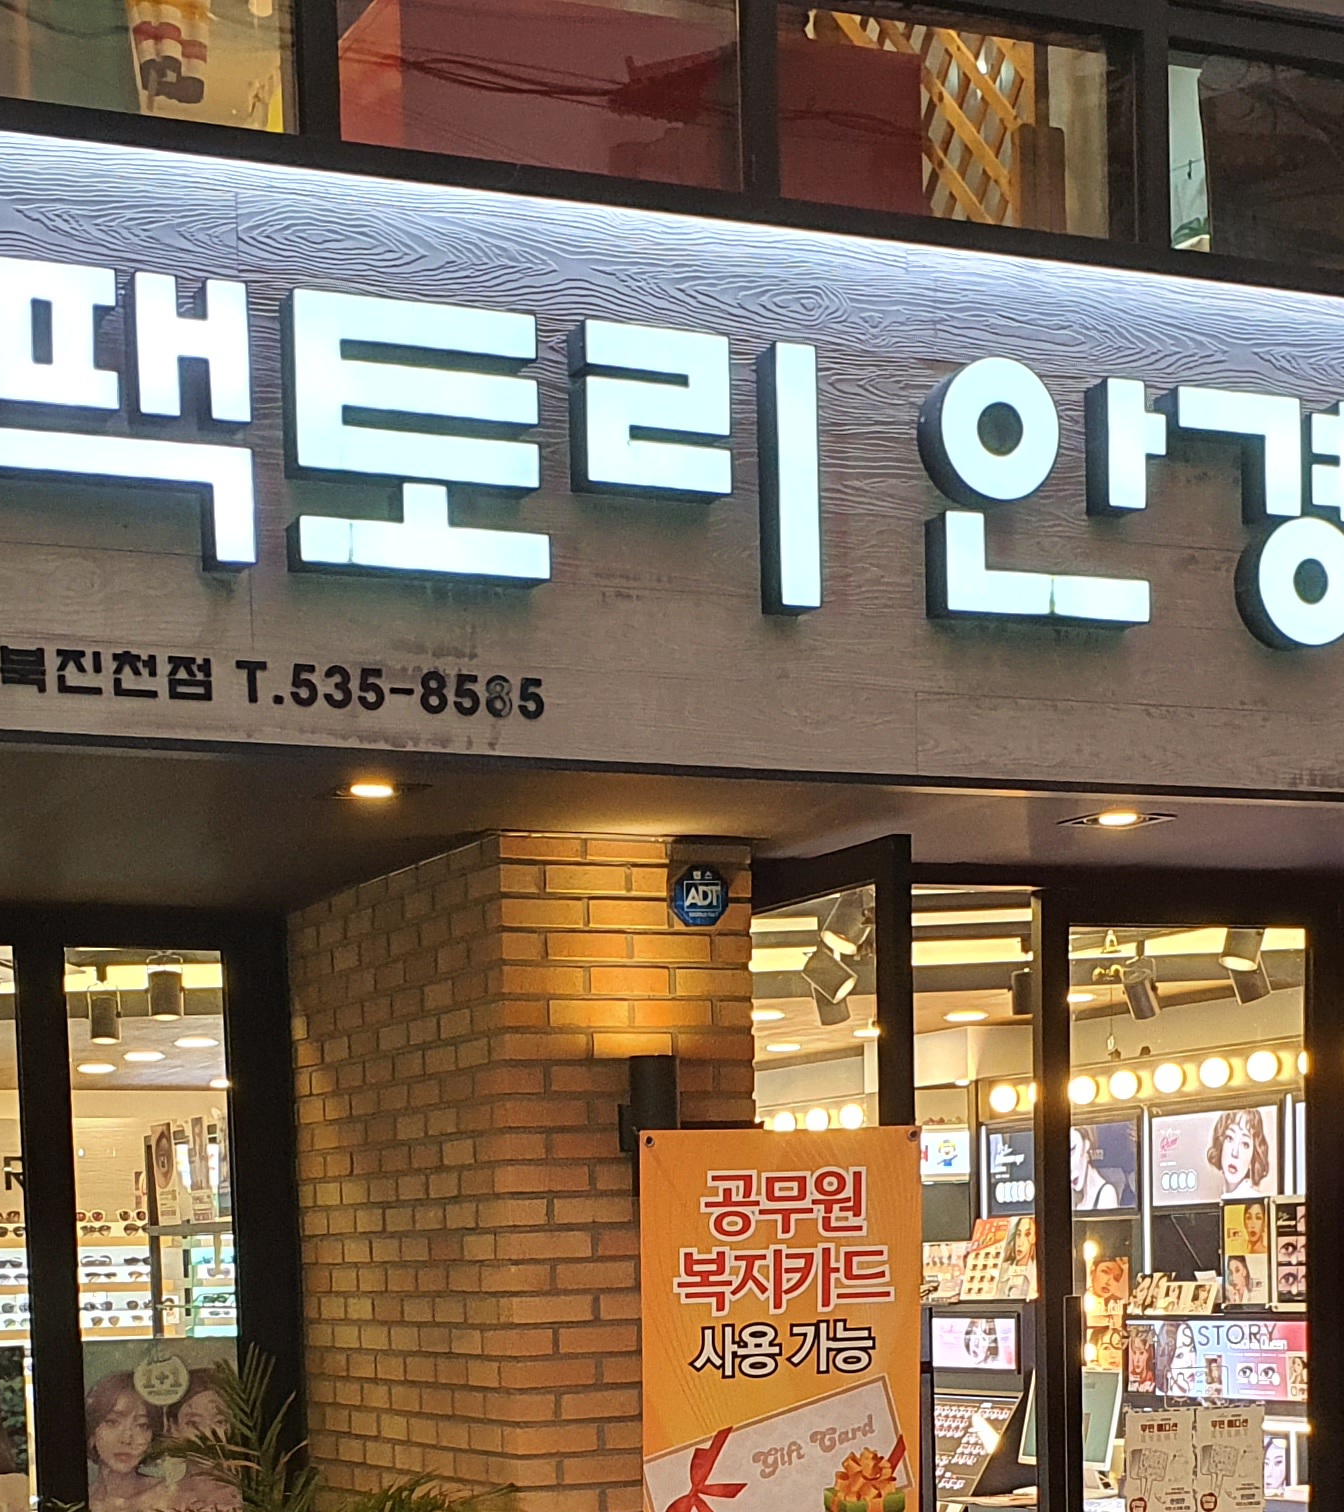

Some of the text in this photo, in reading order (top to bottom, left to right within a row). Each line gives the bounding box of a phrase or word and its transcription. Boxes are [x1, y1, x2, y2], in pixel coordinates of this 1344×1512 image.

[685, 884, 721, 907] ADT
[700, 1165, 868, 1242] 공무원
[672, 1244, 896, 1318] 복지카드
[690, 1318, 877, 1380] 사용 가능
[751, 1414, 876, 1479] Gift Card
